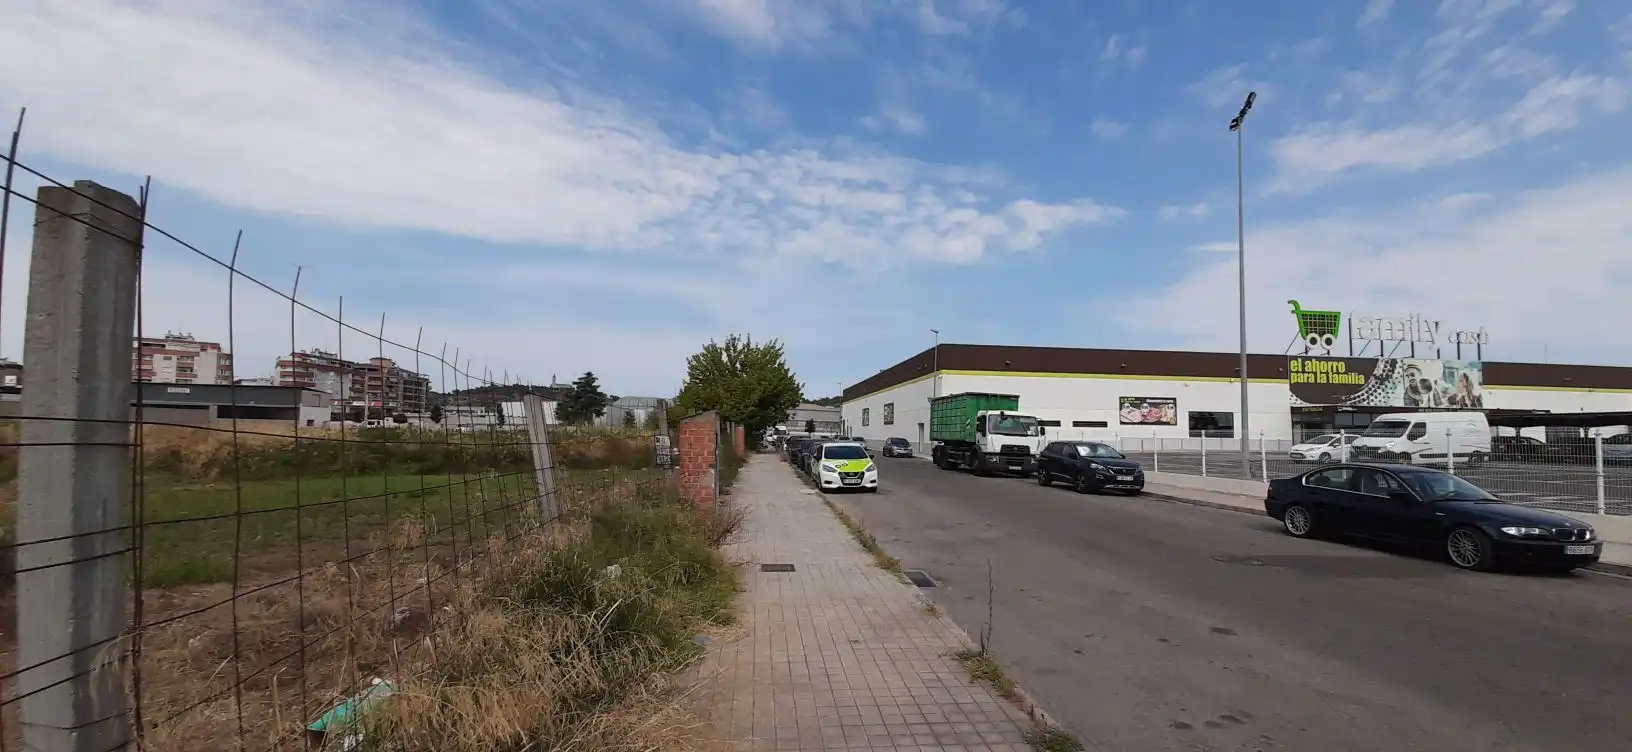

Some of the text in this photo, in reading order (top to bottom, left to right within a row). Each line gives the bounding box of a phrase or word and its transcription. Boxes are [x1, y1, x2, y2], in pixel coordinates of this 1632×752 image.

[1290, 358, 1346, 373] el ahorro
[1290, 371, 1365, 385] para la familia
